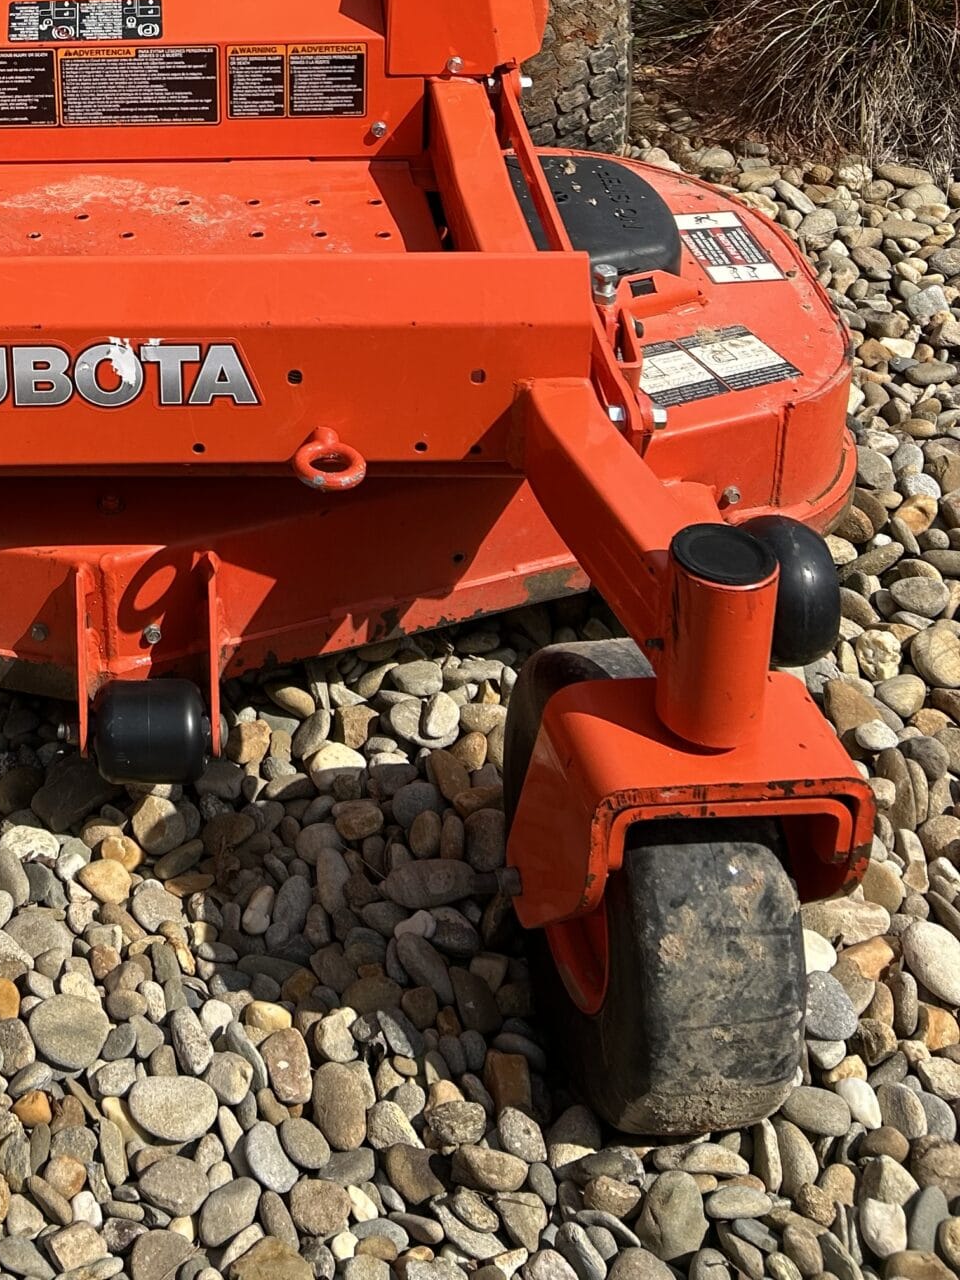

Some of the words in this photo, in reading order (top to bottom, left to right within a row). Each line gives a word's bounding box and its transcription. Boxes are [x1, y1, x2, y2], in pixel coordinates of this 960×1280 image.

[72, 48, 132, 58] ADVERTENCIA
[239, 46, 278, 55] WARNING
[301, 45, 362, 54] ADVERTENCIA
